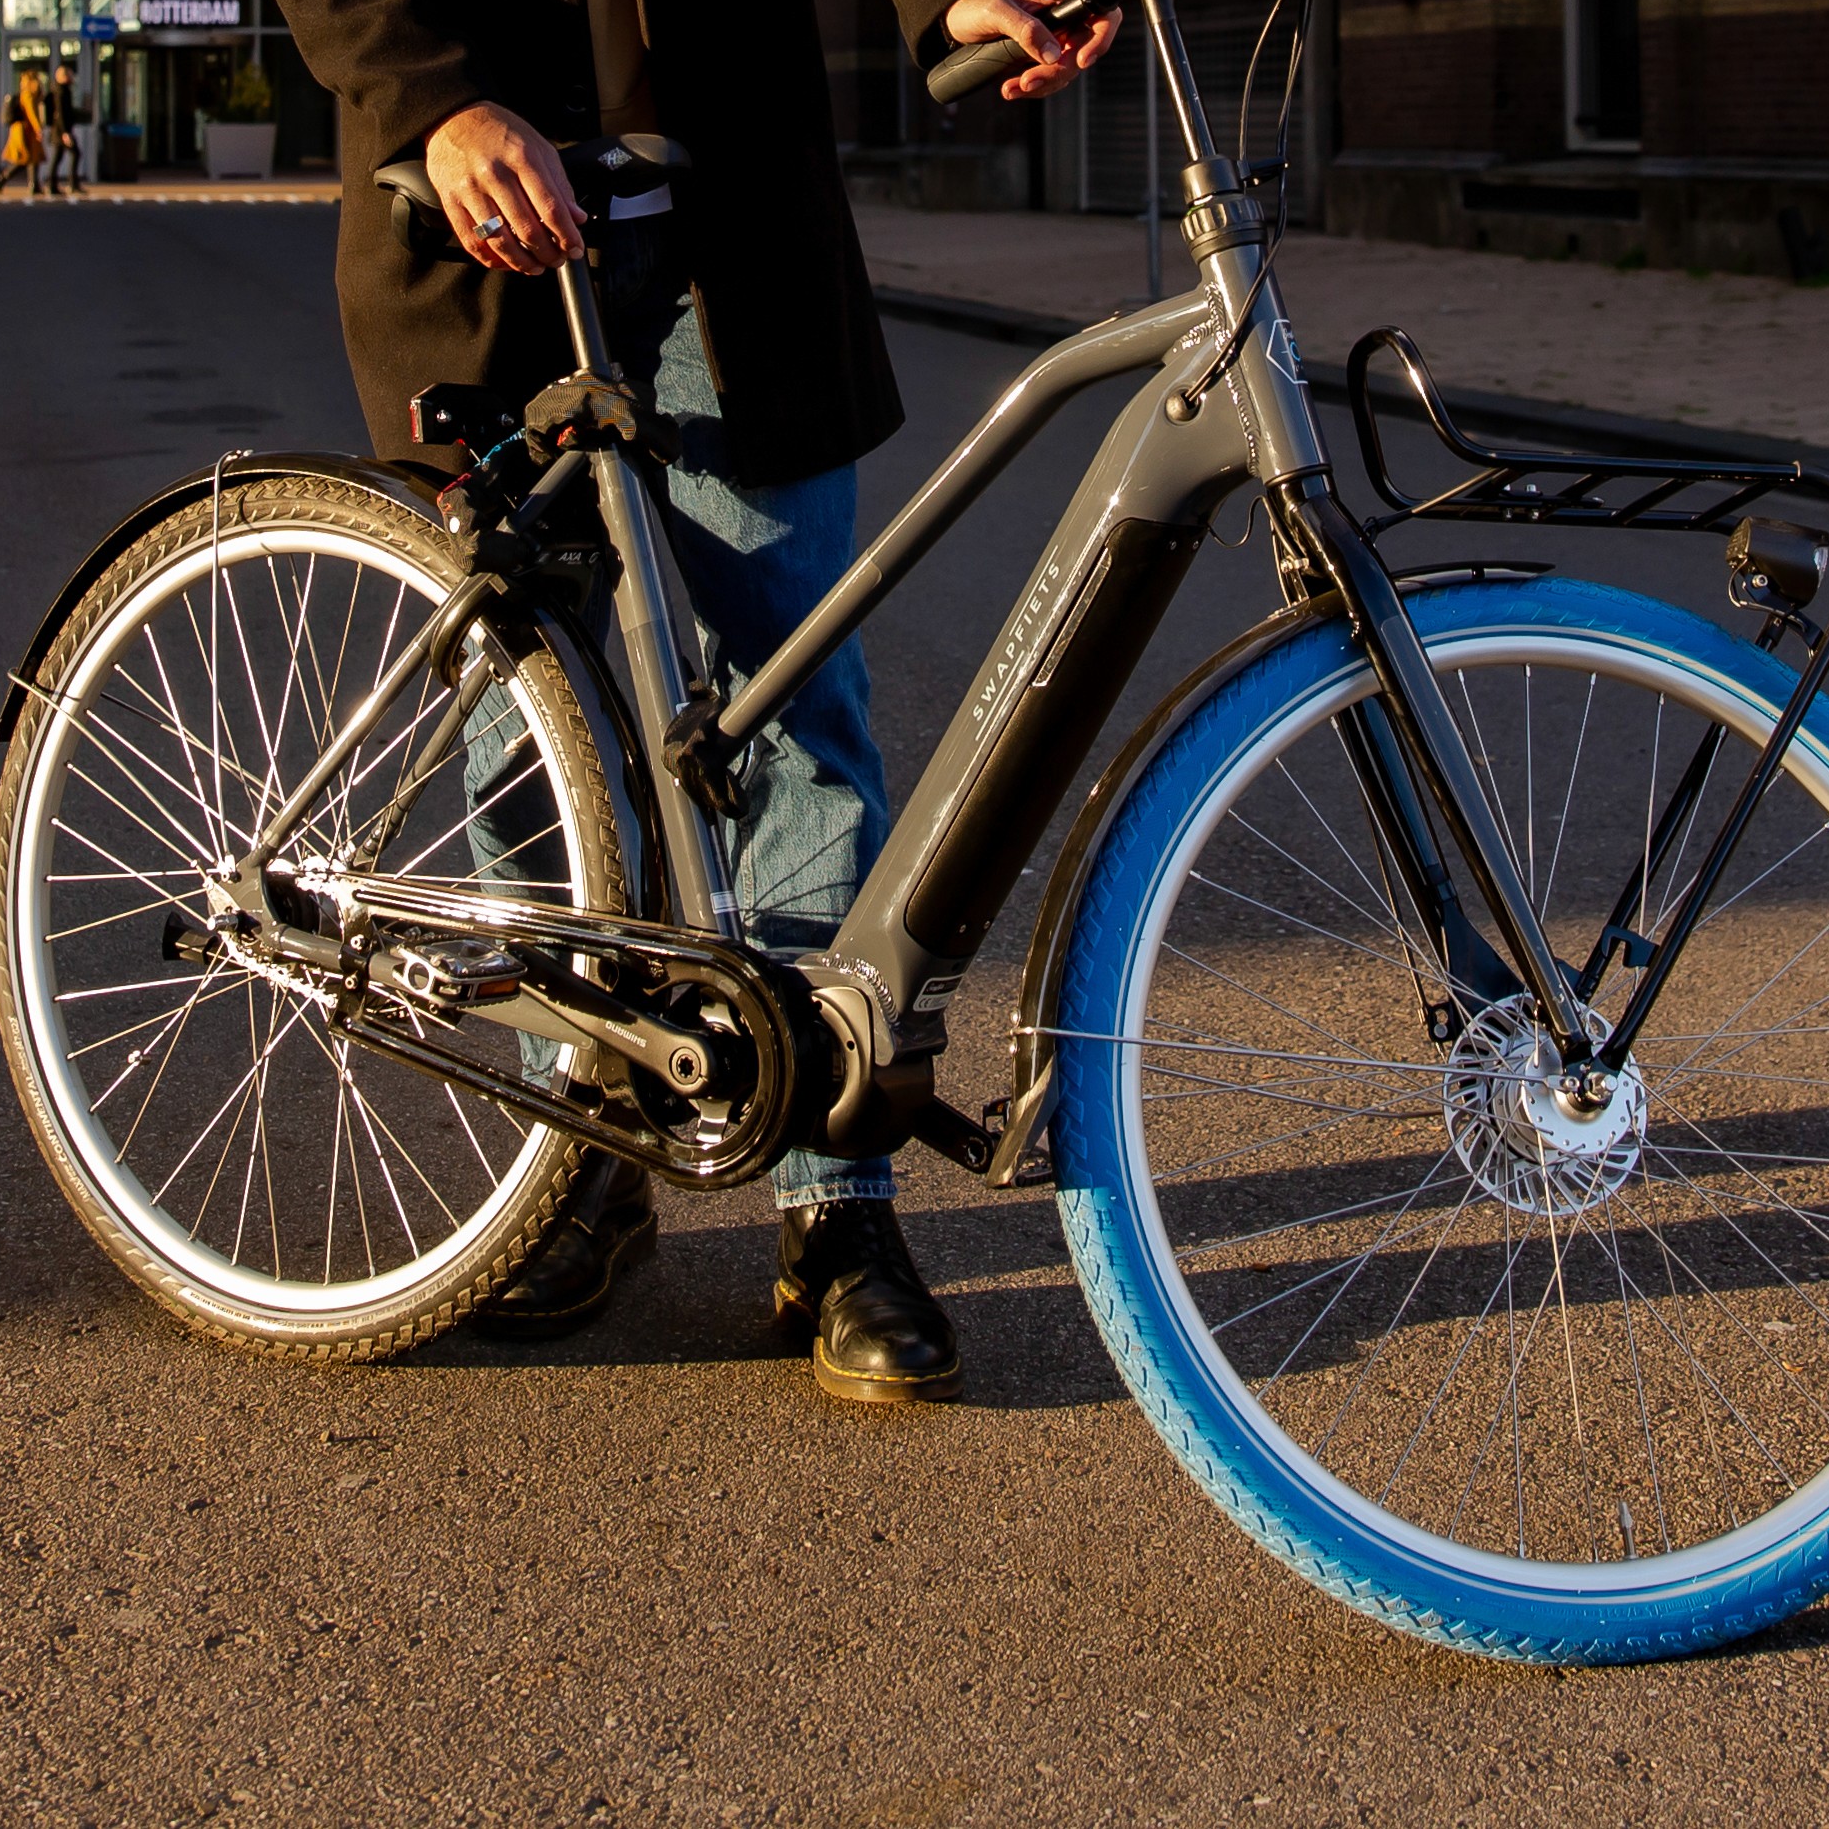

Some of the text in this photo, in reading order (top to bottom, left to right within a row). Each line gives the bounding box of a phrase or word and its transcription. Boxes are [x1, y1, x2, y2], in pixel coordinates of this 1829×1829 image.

[139, 0, 240, 24] ROTTERDAM
[558, 551, 582, 562] AXA
[972, 562, 1060, 721] SWAPFIETS
[605, 1020, 647, 1048] SHIMANO
[25, 1073, 68, 1163] CONTINENTAL
